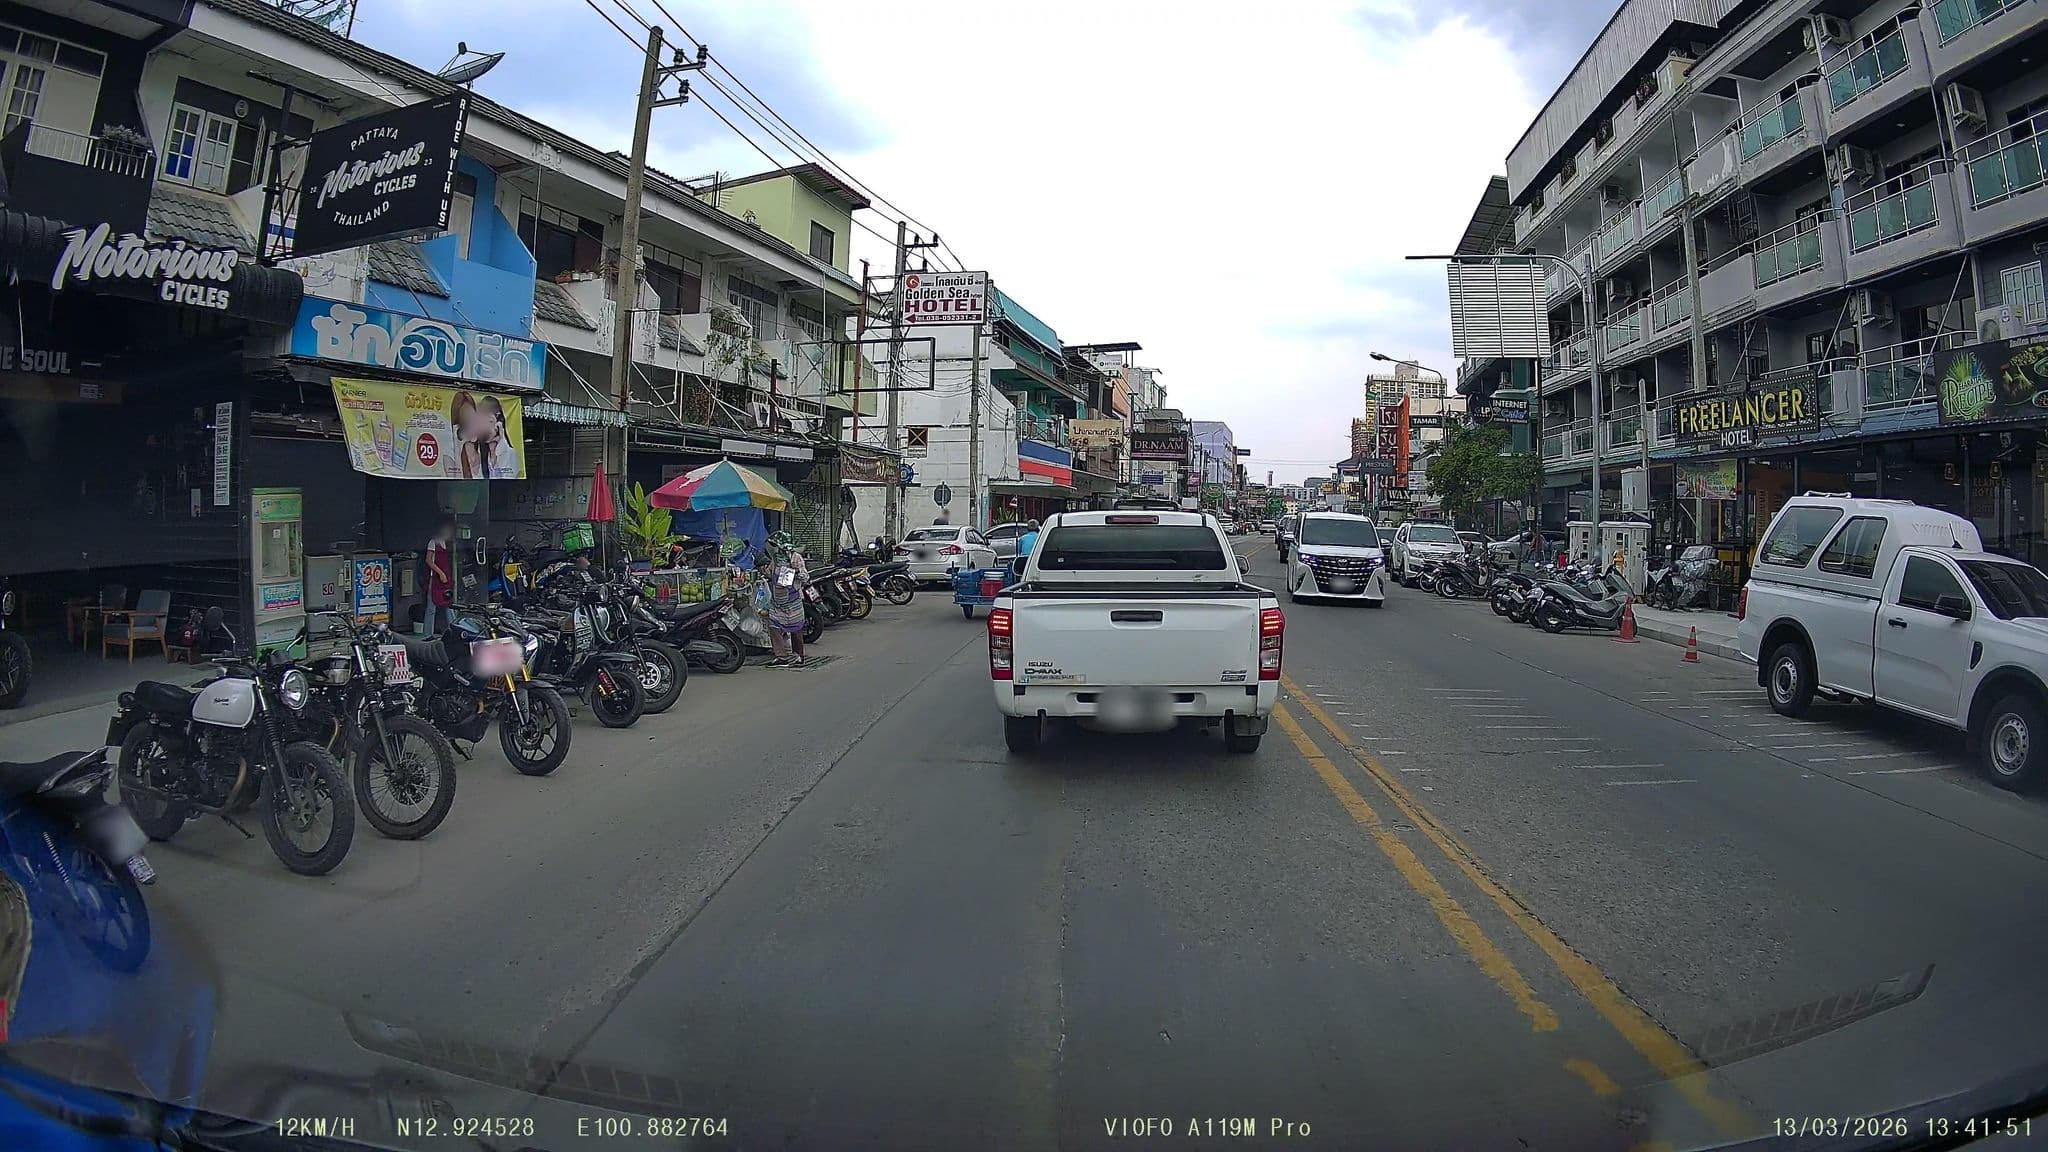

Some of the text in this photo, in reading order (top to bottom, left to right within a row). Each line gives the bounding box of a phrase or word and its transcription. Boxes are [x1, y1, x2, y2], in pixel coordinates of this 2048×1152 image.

[453, 98, 466, 143] RIDE
[351, 127, 399, 151] PATTAYA
[317, 141, 425, 209] Motorious
[442, 147, 458, 194] WITH
[374, 174, 417, 196] CYCLES
[333, 200, 390, 226] THAILAND
[52, 222, 239, 290] Motorious
[161, 280, 230, 310] CYCLES
[905, 287, 944, 299] Golden
[948, 287, 970, 298] Sea
[905, 299, 982, 312] HOTEL
[20, 348, 71, 374] SOUL
[1492, 399, 1527, 409] INTERNET
[1679, 388, 1804, 434] FREELANCER
[1413, 417, 1437, 425] TAMAR
[1134, 440, 1184, 450] DR.NAAM
[1721, 429, 1752, 447] HOTEL
[1388, 489, 1411, 499] WAX
[362, 564, 383, 585] 30
[323, 584, 334, 595] 30
